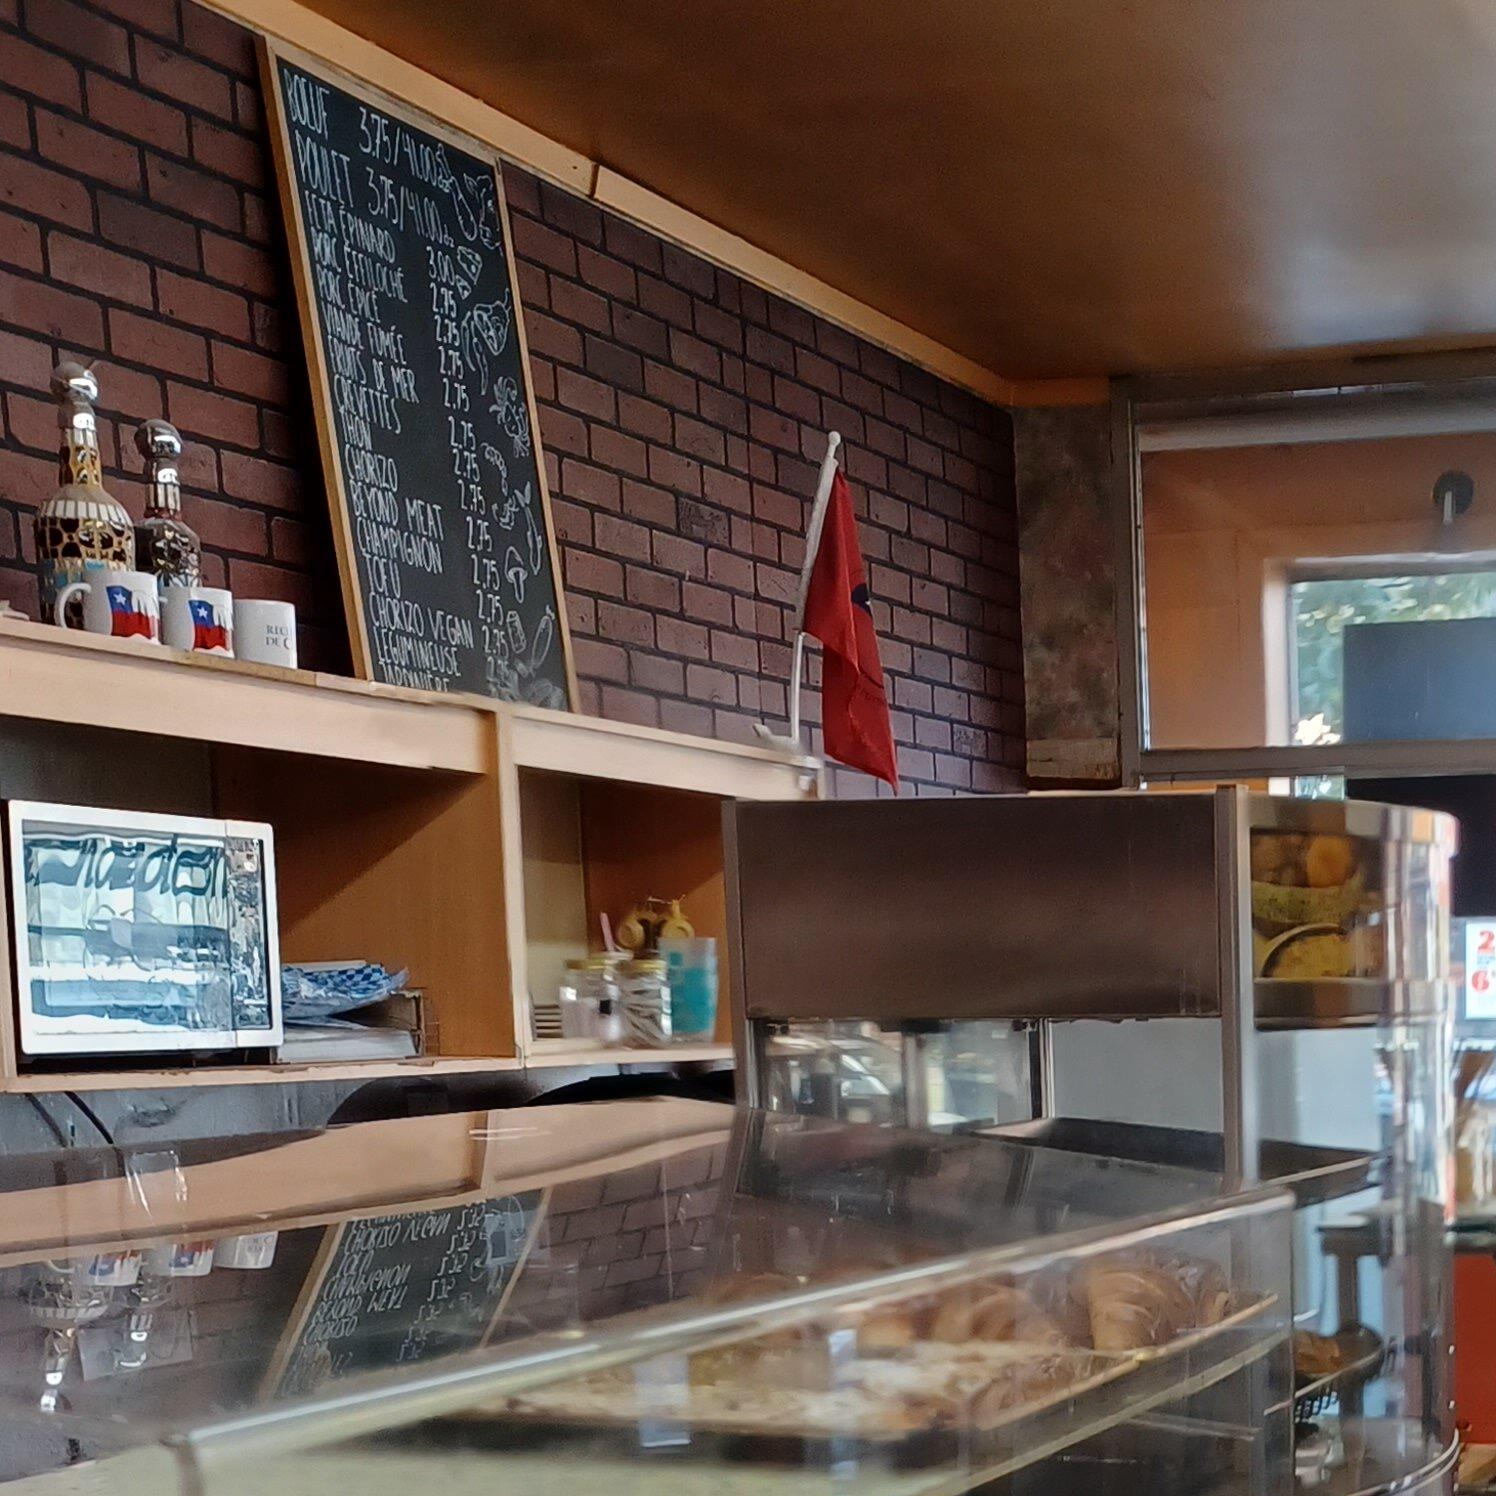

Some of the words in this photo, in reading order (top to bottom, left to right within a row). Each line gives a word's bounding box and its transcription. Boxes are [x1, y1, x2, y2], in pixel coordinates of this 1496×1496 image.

[294, 129, 354, 208] POULET
[304, 190, 338, 236] FETA
[427, 246, 456, 286] 3.00
[311, 226, 341, 272] PORC
[430, 282, 457, 318] 2.75
[316, 263, 346, 310] PORC
[434, 315, 460, 346] 2.75
[321, 300, 364, 350] VIANDE
[438, 346, 464, 380] 2.75
[328, 334, 366, 385] FRUITS
[372, 358, 388, 393] DE
[390, 365, 420, 404] MER
[443, 378, 470, 412] 2.75
[334, 373, 402, 434] CREVETTES
[448, 416, 477, 450] 2.75
[339, 405, 373, 451] THON
[453, 449, 481, 482] 2.75
[345, 443, 398, 492] CHORIZO
[457, 479, 487, 515] 2.75
[350, 479, 399, 526] BEYOND
[405, 497, 444, 541] MEAT
[466, 516, 493, 552] 2.75
[356, 516, 443, 574] CHAMPIGNON
[470, 554, 500, 591] 2.75
[362, 549, 401, 599] TOFU
[476, 589, 504, 626] 2.75
[369, 592, 425, 638] CHORIZO
[427, 606, 474, 649] VEGAN
[481, 625, 510, 661] 2.75
